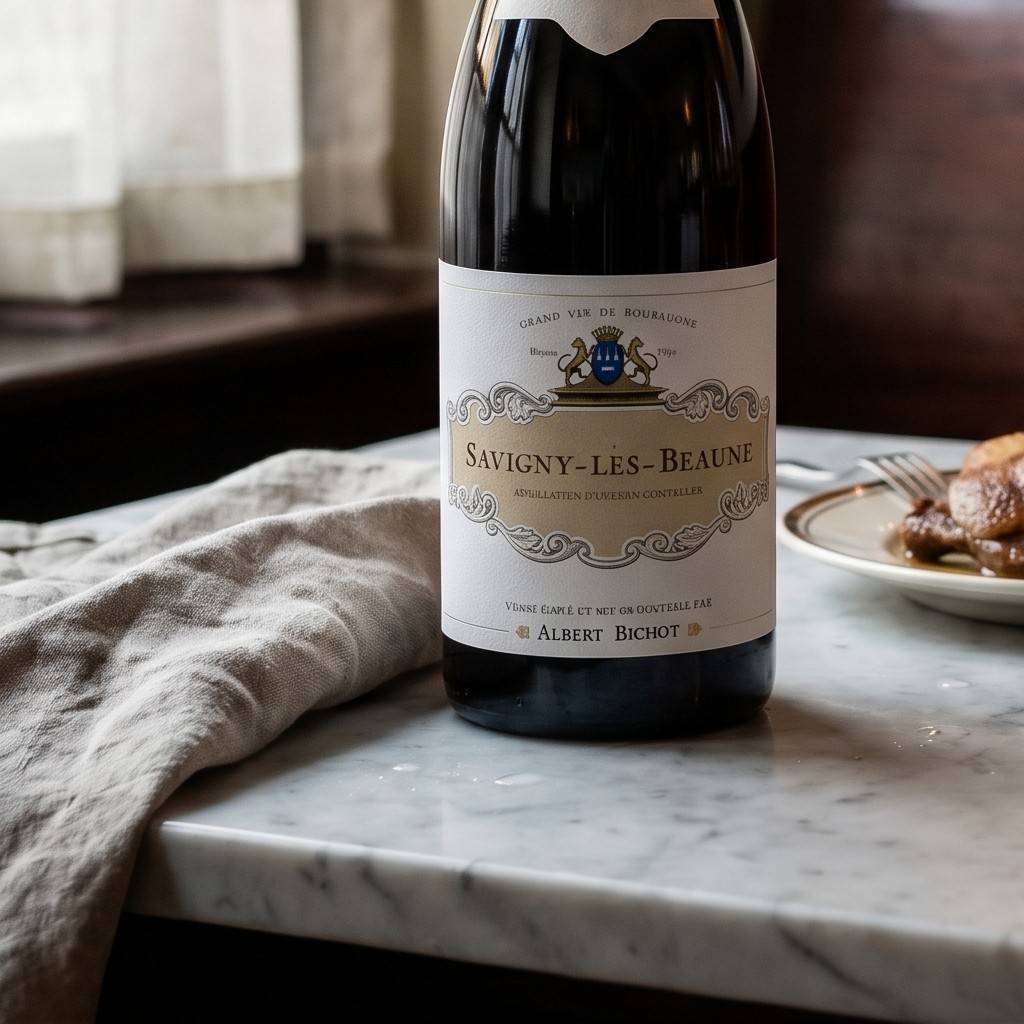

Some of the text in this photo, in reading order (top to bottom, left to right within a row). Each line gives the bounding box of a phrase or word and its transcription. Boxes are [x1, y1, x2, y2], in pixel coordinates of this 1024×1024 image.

[519, 312, 560, 329] GRAND
[600, 308, 616, 317] DE
[537, 624, 680, 642] ALBERT BICHOT
